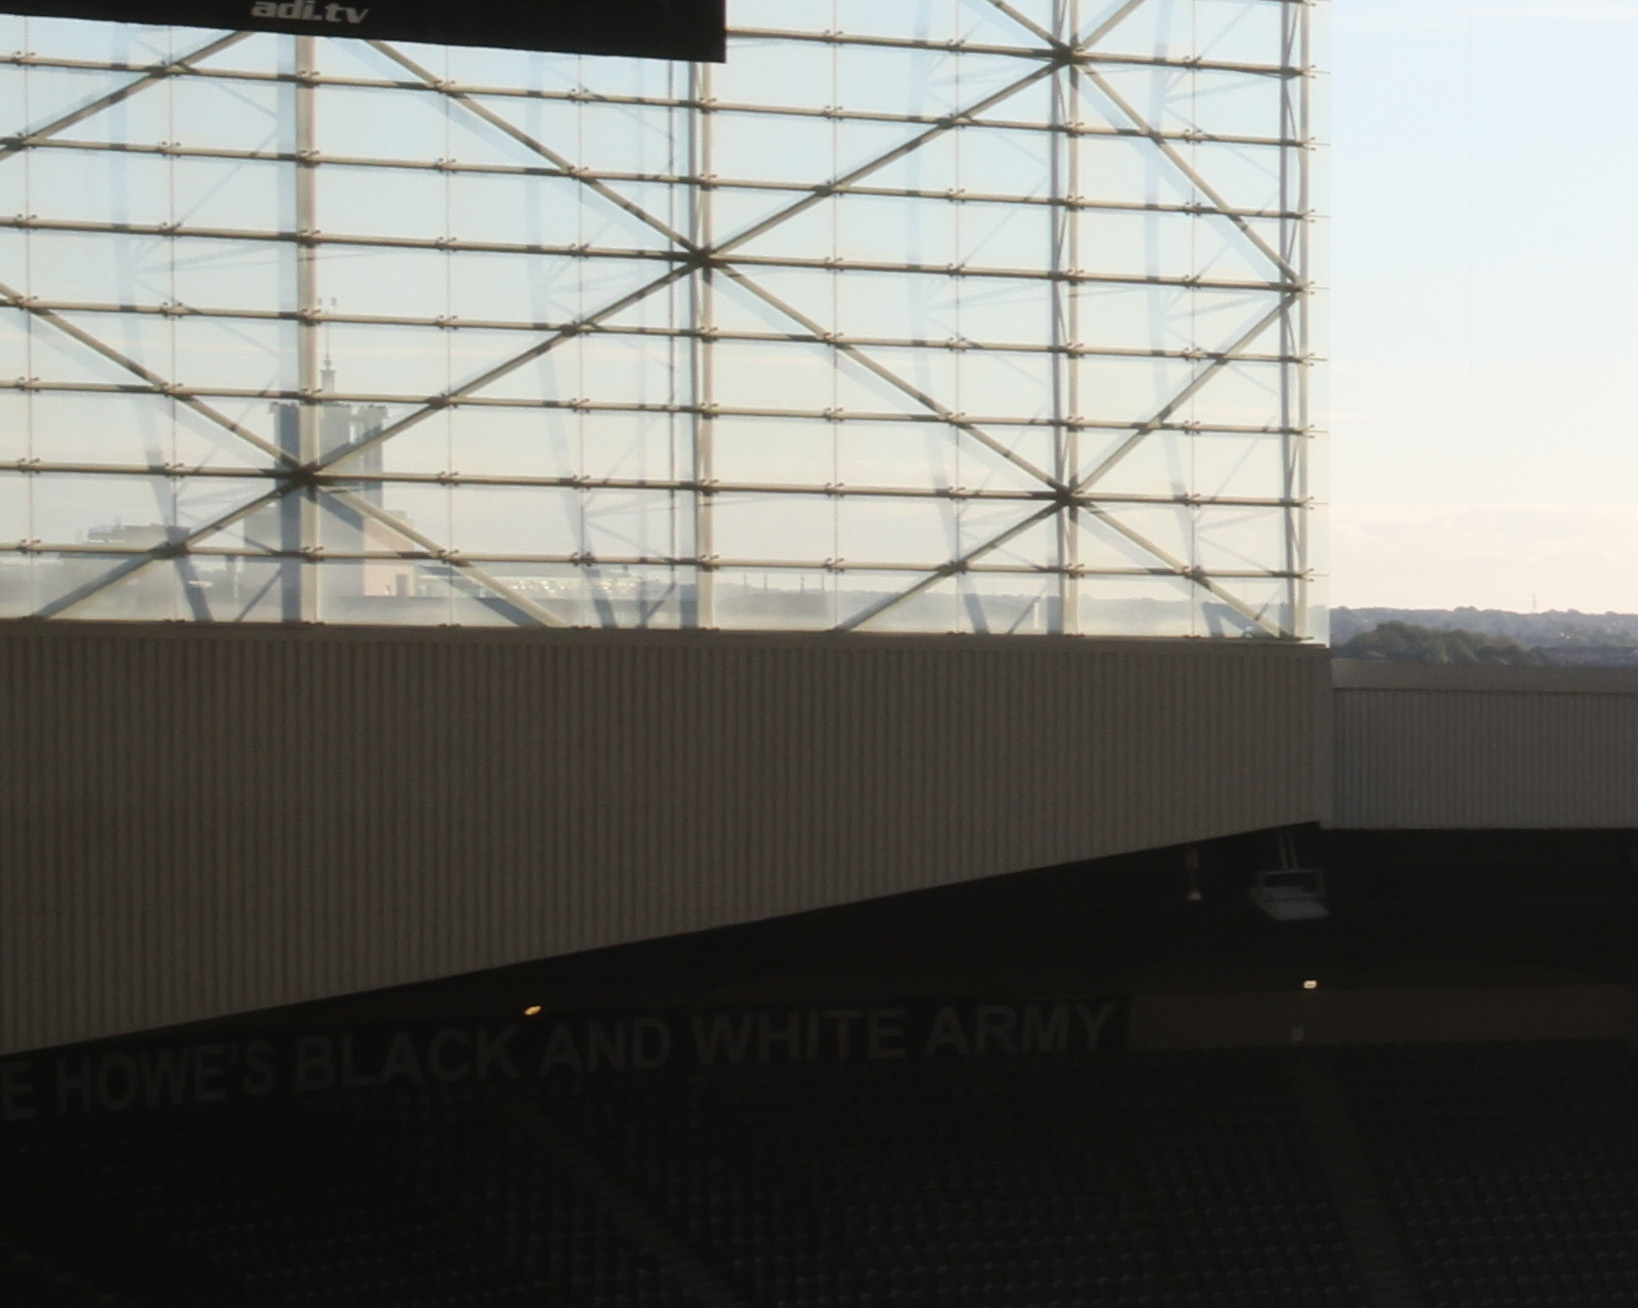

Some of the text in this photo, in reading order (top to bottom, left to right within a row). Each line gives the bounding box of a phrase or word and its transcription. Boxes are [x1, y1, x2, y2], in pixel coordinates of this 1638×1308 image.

[252, 0, 370, 24] adi.tv
[55, 1038, 275, 1116] HOWE'S
[295, 1024, 520, 1092] BLACK
[540, 1016, 672, 1076] AND
[693, 1006, 907, 1066] WHITE
[924, 1000, 1114, 1057] ARMY
